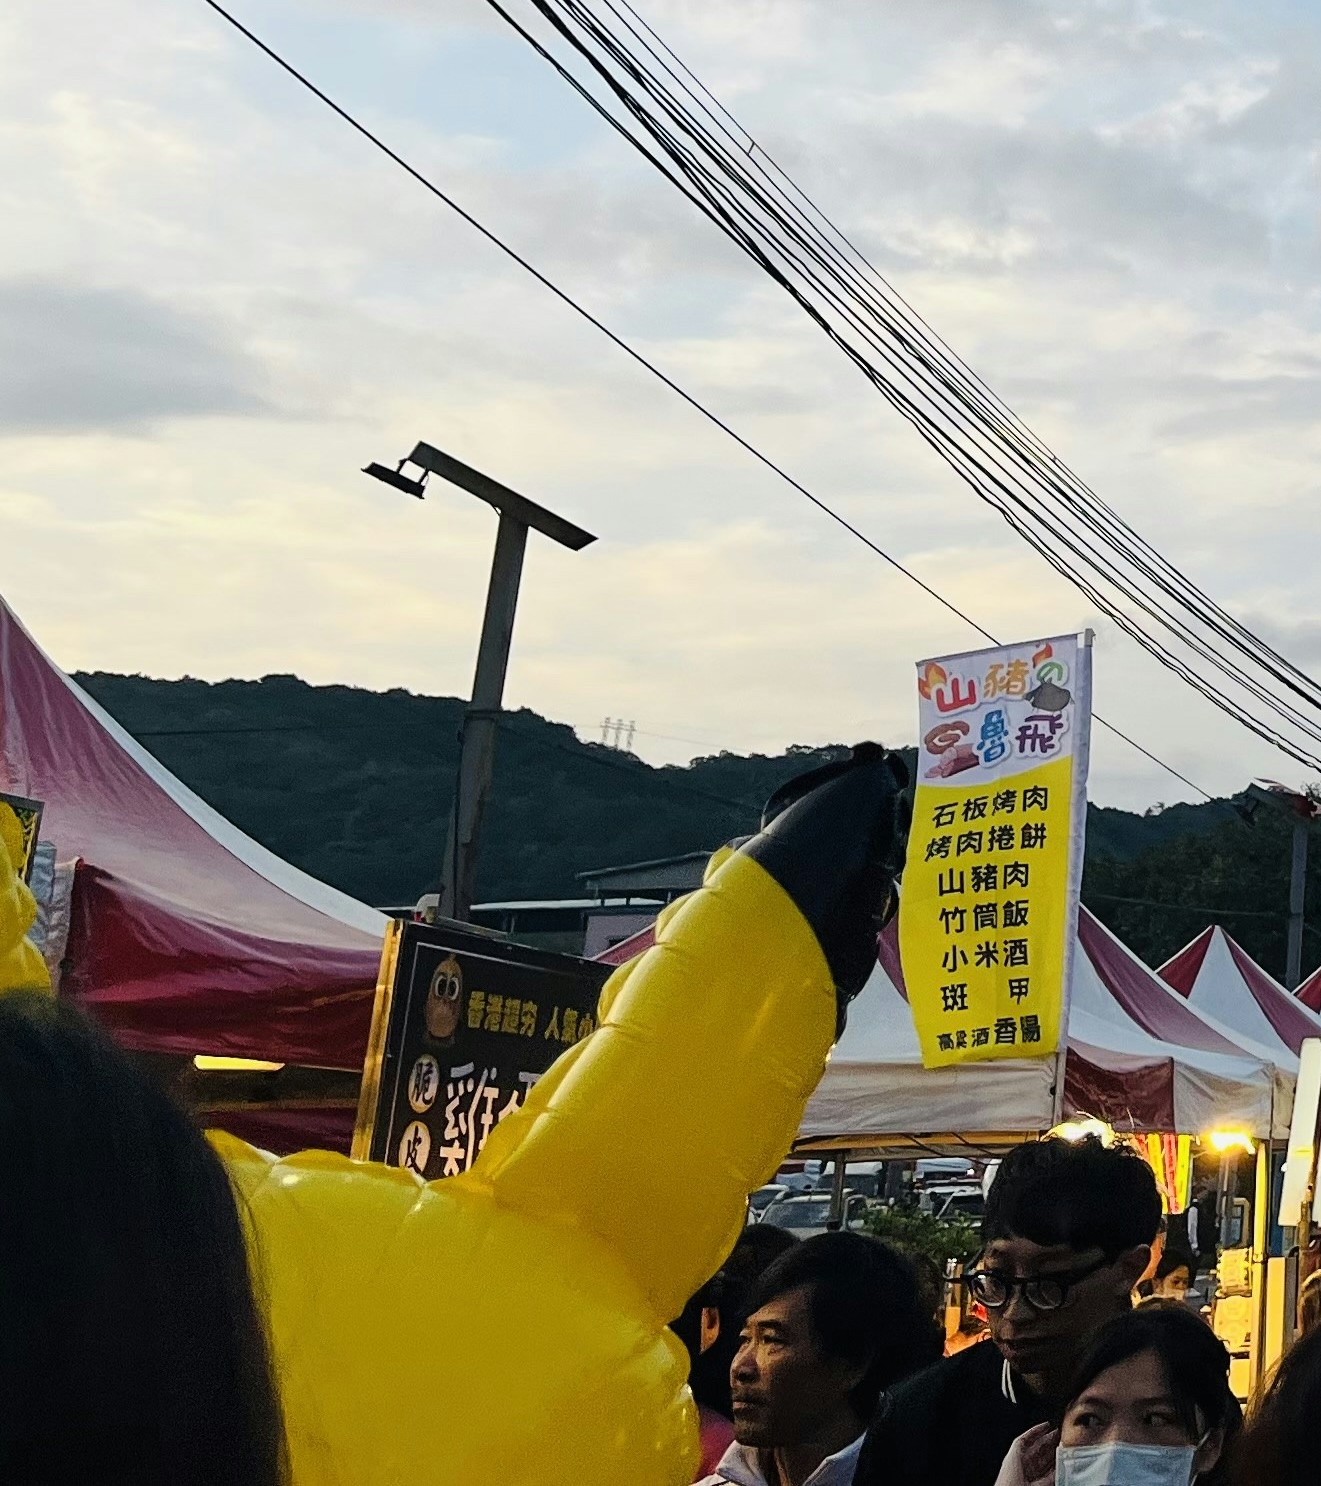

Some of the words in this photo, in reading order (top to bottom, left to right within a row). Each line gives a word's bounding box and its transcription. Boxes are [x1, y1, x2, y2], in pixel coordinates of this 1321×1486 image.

[931, 784, 1049, 829] 石板烤肉
[924, 822, 1048, 863] 烤肉捲餅
[938, 860, 1030, 897] 山豬肉
[938, 899, 1030, 935] 竹筒飯
[941, 938, 1030, 973] 小米酒
